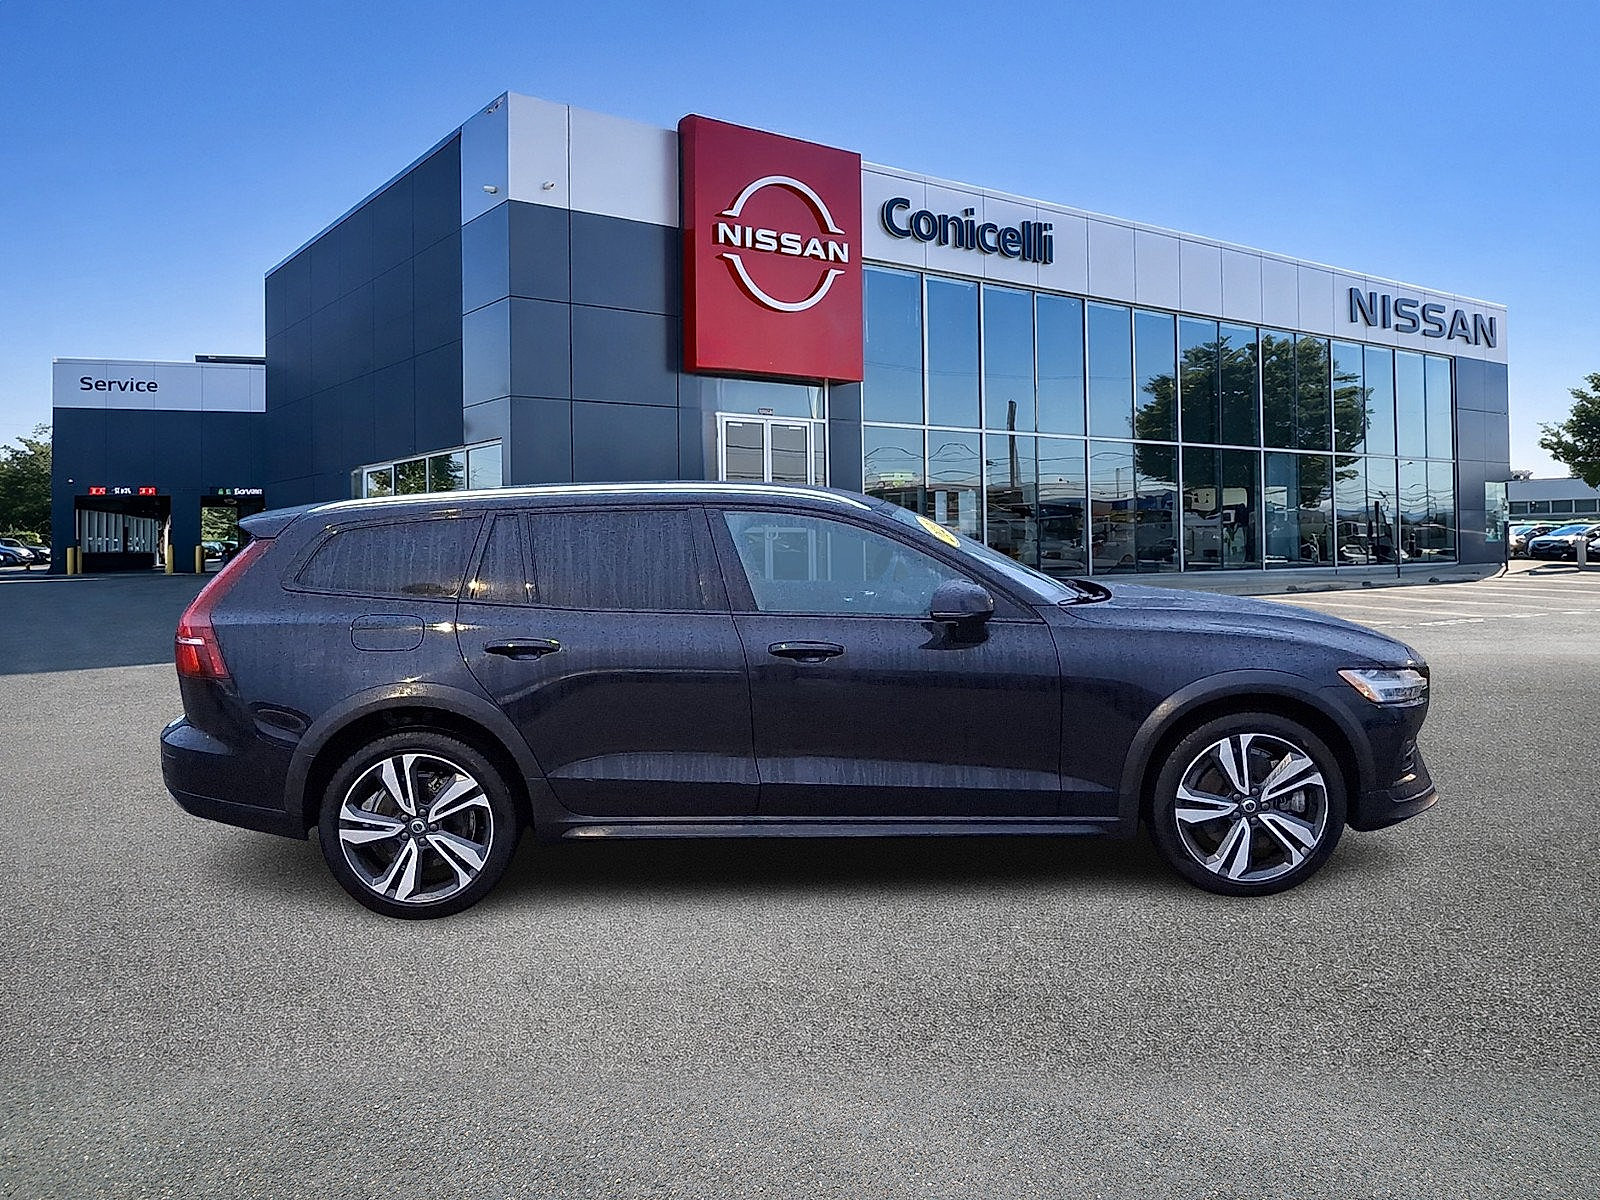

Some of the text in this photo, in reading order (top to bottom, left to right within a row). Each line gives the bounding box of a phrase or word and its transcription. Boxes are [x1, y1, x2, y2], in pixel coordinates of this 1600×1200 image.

[718, 222, 849, 263] NISSAN
[882, 197, 1053, 264] Conicelli
[1349, 287, 1497, 348] NISSAN
[79, 376, 158, 392] Service
